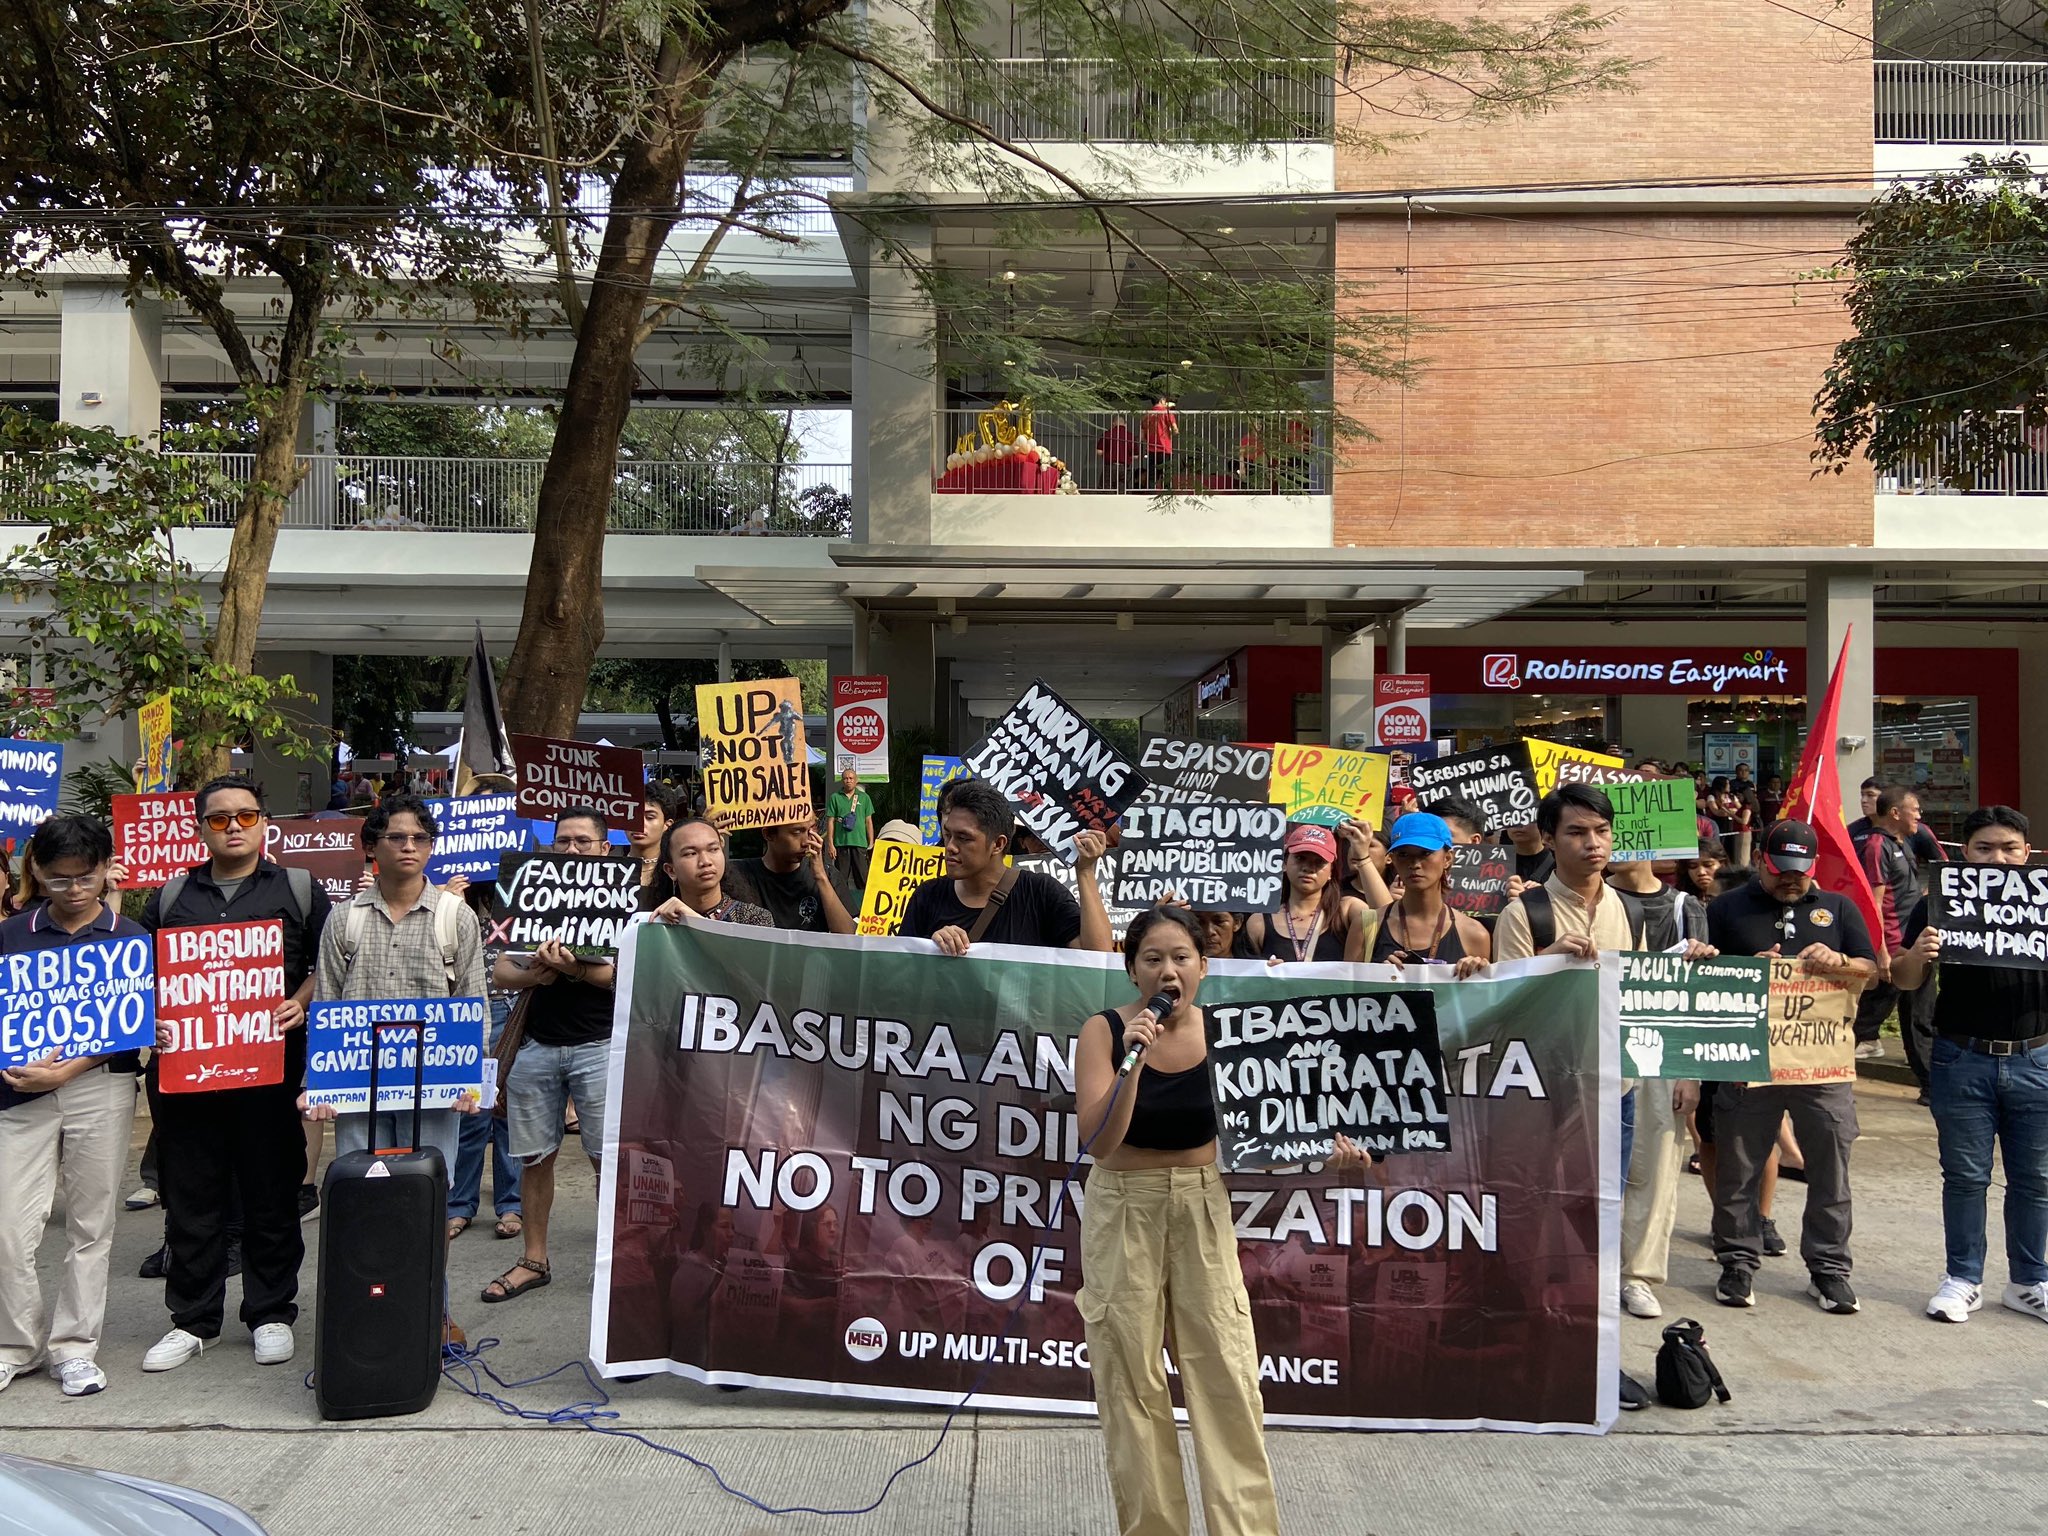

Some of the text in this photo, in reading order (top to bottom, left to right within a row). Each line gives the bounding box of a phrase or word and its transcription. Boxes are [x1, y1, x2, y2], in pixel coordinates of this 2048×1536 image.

[1525, 660, 1663, 680] Robinsons
[1669, 659, 1788, 691] Easymart
[1395, 687, 1425, 695] Easymart
[715, 690, 777, 736] UP
[843, 715, 878, 726] NOW
[1384, 715, 1421, 726] NOW
[843, 726, 879, 737] OPEN
[1016, 685, 1132, 798] MURANG
[1384, 726, 1421, 737] OPEN
[545, 744, 601, 768] JUNK
[717, 735, 783, 764] NOT
[1003, 711, 1081, 791] KAINAN
[1140, 737, 1271, 781] ESPASYO
[1277, 748, 1376, 777] UP NOT
[526, 762, 632, 797] DILIMALL
[966, 736, 1034, 802] ISKO
[1029, 763, 1048, 787] SA
[1174, 771, 1220, 792] HINDI
[1325, 771, 1368, 792] FOR
[1413, 754, 1511, 788] SERBISYO SA
[708, 762, 807, 804] FOR SALE!
[1460, 770, 1525, 800] HUWAG
[519, 787, 640, 820] CONTRACT
[788, 803, 810, 820] UPD
[124, 818, 198, 844] ESPAS
[448, 818, 466, 830] sa
[471, 814, 506, 832] mga
[1484, 806, 1538, 832] NEGOSY
[1616, 816, 1650, 831] is not
[283, 832, 312, 849] NOT
[1182, 838, 1216, 854] ang
[1489, 847, 1508, 861] SA
[523, 859, 636, 886] FACULTY
[1121, 848, 1284, 875] PAMPUBLIKONG
[325, 878, 353, 892] SALE
[1117, 876, 1229, 904] KARAKTER
[1230, 886, 1248, 899] NG
[1246, 876, 1282, 907] UP
[519, 884, 641, 915] COMMONS
[1945, 899, 1978, 918] SA
[861, 915, 888, 926] NRY
[862, 925, 885, 936] UPD
[165, 924, 283, 964] IBASURA
[203, 958, 235, 971] ANG
[1618, 956, 1694, 983] FACULTY
[4, 972, 154, 1013] TAO WAG GAWING
[159, 966, 286, 1009] KONTRATA
[1618, 989, 1690, 1012] HINDI
[211, 1002, 229, 1013] NG
[315, 1001, 483, 1030] SERBISYO SA TAO
[1783, 994, 1815, 1020] UP
[1212, 994, 1418, 1049] IBASURA
[677, 992, 969, 1083] IBASURA
[1286, 1038, 1341, 1059] ANG
[1215, 1048, 1437, 1102] KONTRATA
[308, 1090, 367, 1106] KABATAAN
[1223, 1087, 1449, 1134] NG DILIMALL
[875, 1089, 982, 1154] NG
[1402, 1127, 1446, 1150] KAL
[633, 1174, 670, 1195] UNAHIN
[721, 1147, 942, 1218] NO TO
[971, 1240, 1066, 1304] OF
[847, 1331, 884, 1348] MSA
[899, 1330, 938, 1359] UP
